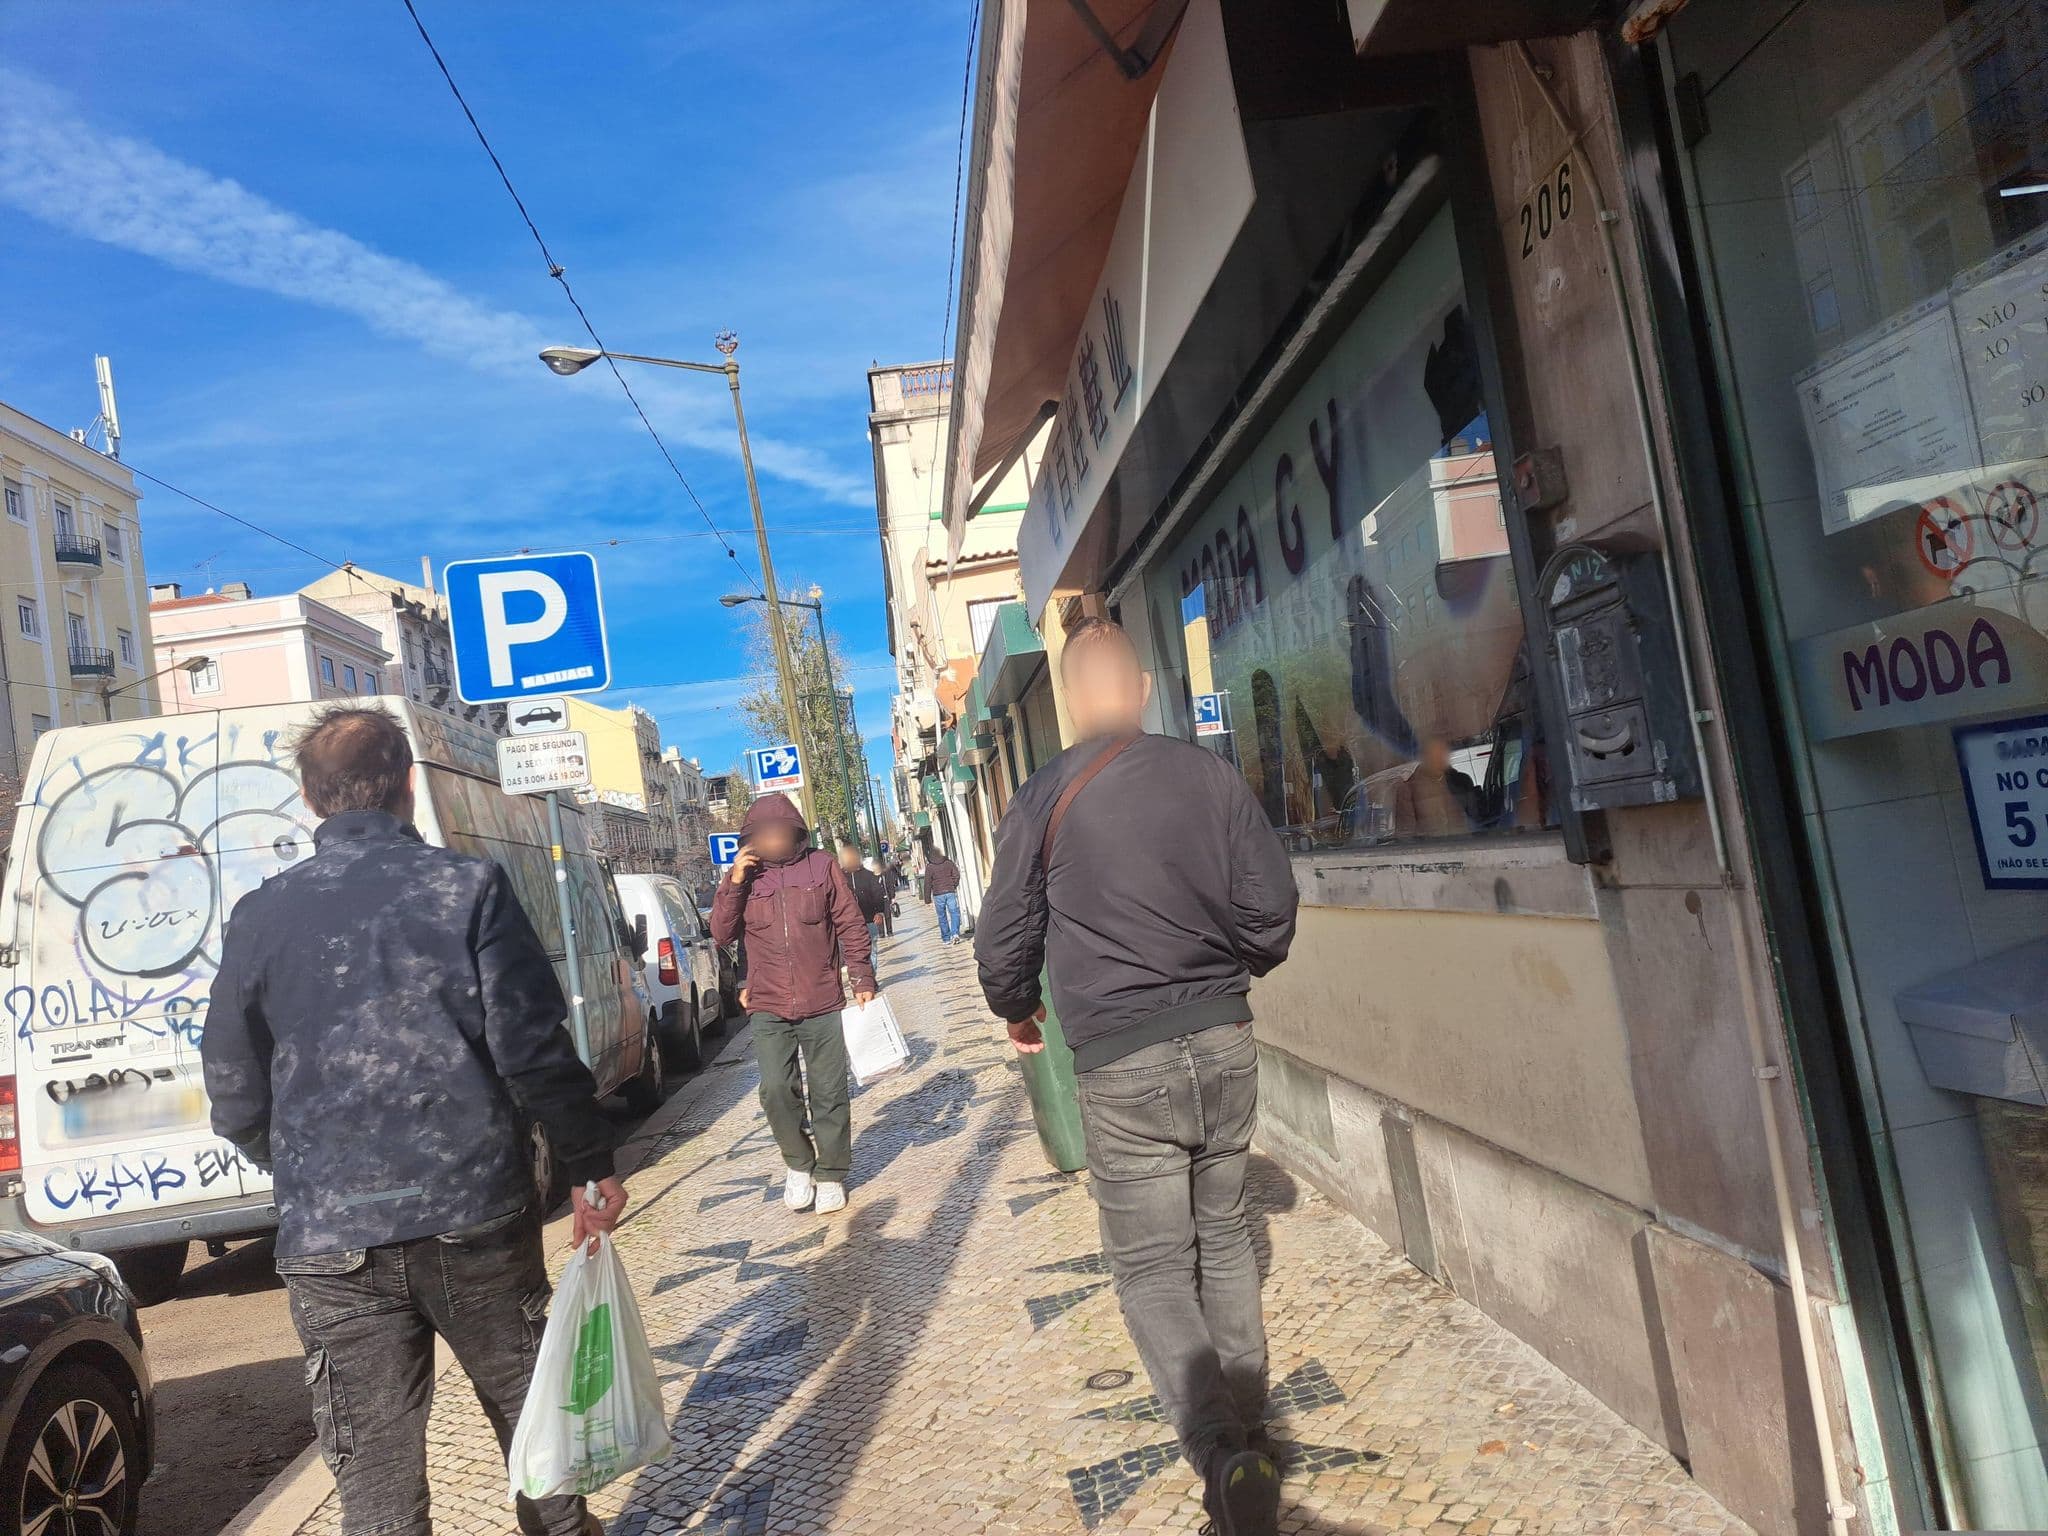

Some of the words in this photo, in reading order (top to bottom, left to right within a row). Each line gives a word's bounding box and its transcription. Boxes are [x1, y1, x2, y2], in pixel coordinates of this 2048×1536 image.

[1520, 162, 1572, 260] 206
[1976, 301, 2017, 334] NÃO
[1984, 337, 2010, 363] AO
[478, 570, 567, 688] P
[1842, 616, 2012, 712] MODA
[506, 744, 527, 754] PAGO
[529, 743, 539, 752] DE
[761, 752, 776, 774] P
[506, 777, 522, 786] DAS
[1996, 770, 2029, 792] NO
[2004, 801, 2037, 848] 5
[717, 837, 739, 862] P
[2025, 858, 2041, 868] SE
[51, 1034, 127, 1054] TRANSIT
